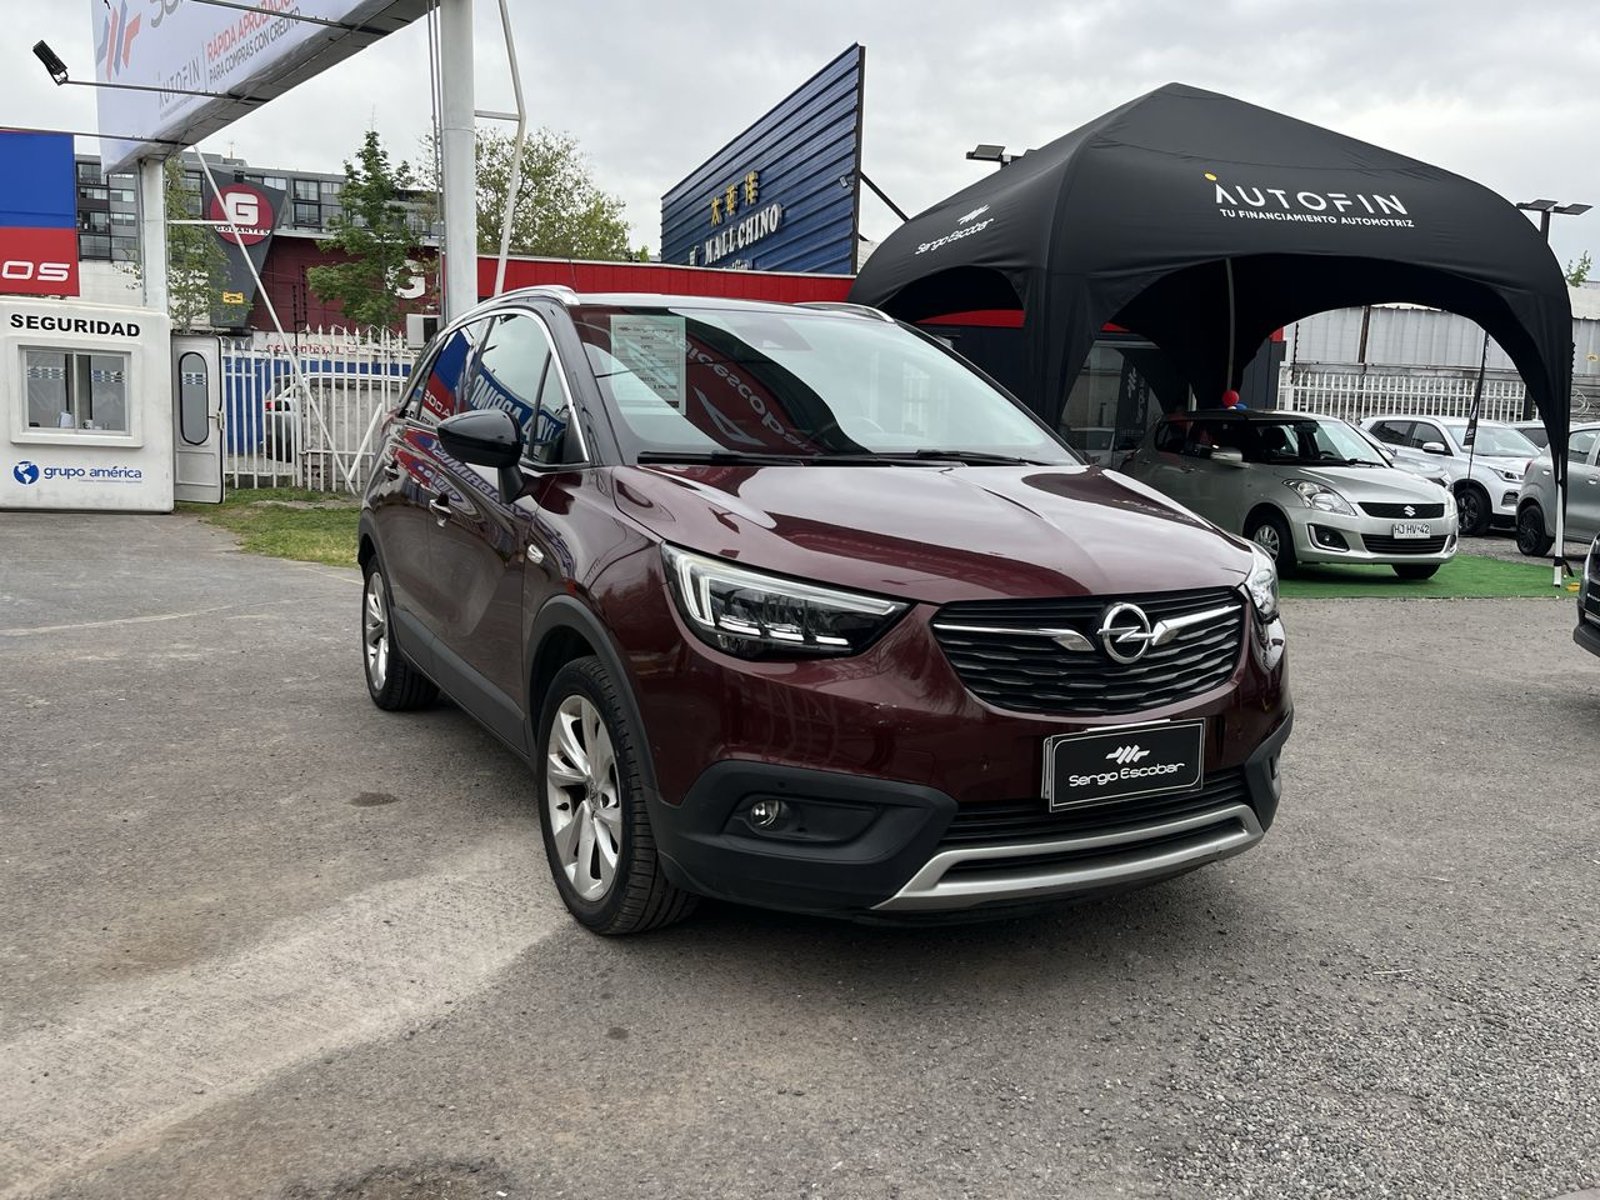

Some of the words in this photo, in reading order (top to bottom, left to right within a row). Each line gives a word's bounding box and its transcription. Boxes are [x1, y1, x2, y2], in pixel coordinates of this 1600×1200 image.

[209, 61, 226, 84] PARA
[225, 40, 255, 74] COMPRAS
[254, 29, 270, 53] CON
[225, 192, 258, 225] G
[1215, 183, 1408, 215] AUTOFIN
[1220, 208, 1236, 218] TU
[1238, 210, 1338, 225] FINANCIAMIENTO
[1341, 216, 1415, 228] AUTOMOTRIZ
[705, 226, 736, 265] MALL
[737, 203, 782, 249] CHINO
[10, 314, 141, 337] SEGURIDAD
[43, 467, 86, 480] grupo
[89, 466, 142, 479] américa
[1120, 762, 1186, 780] Escobar
